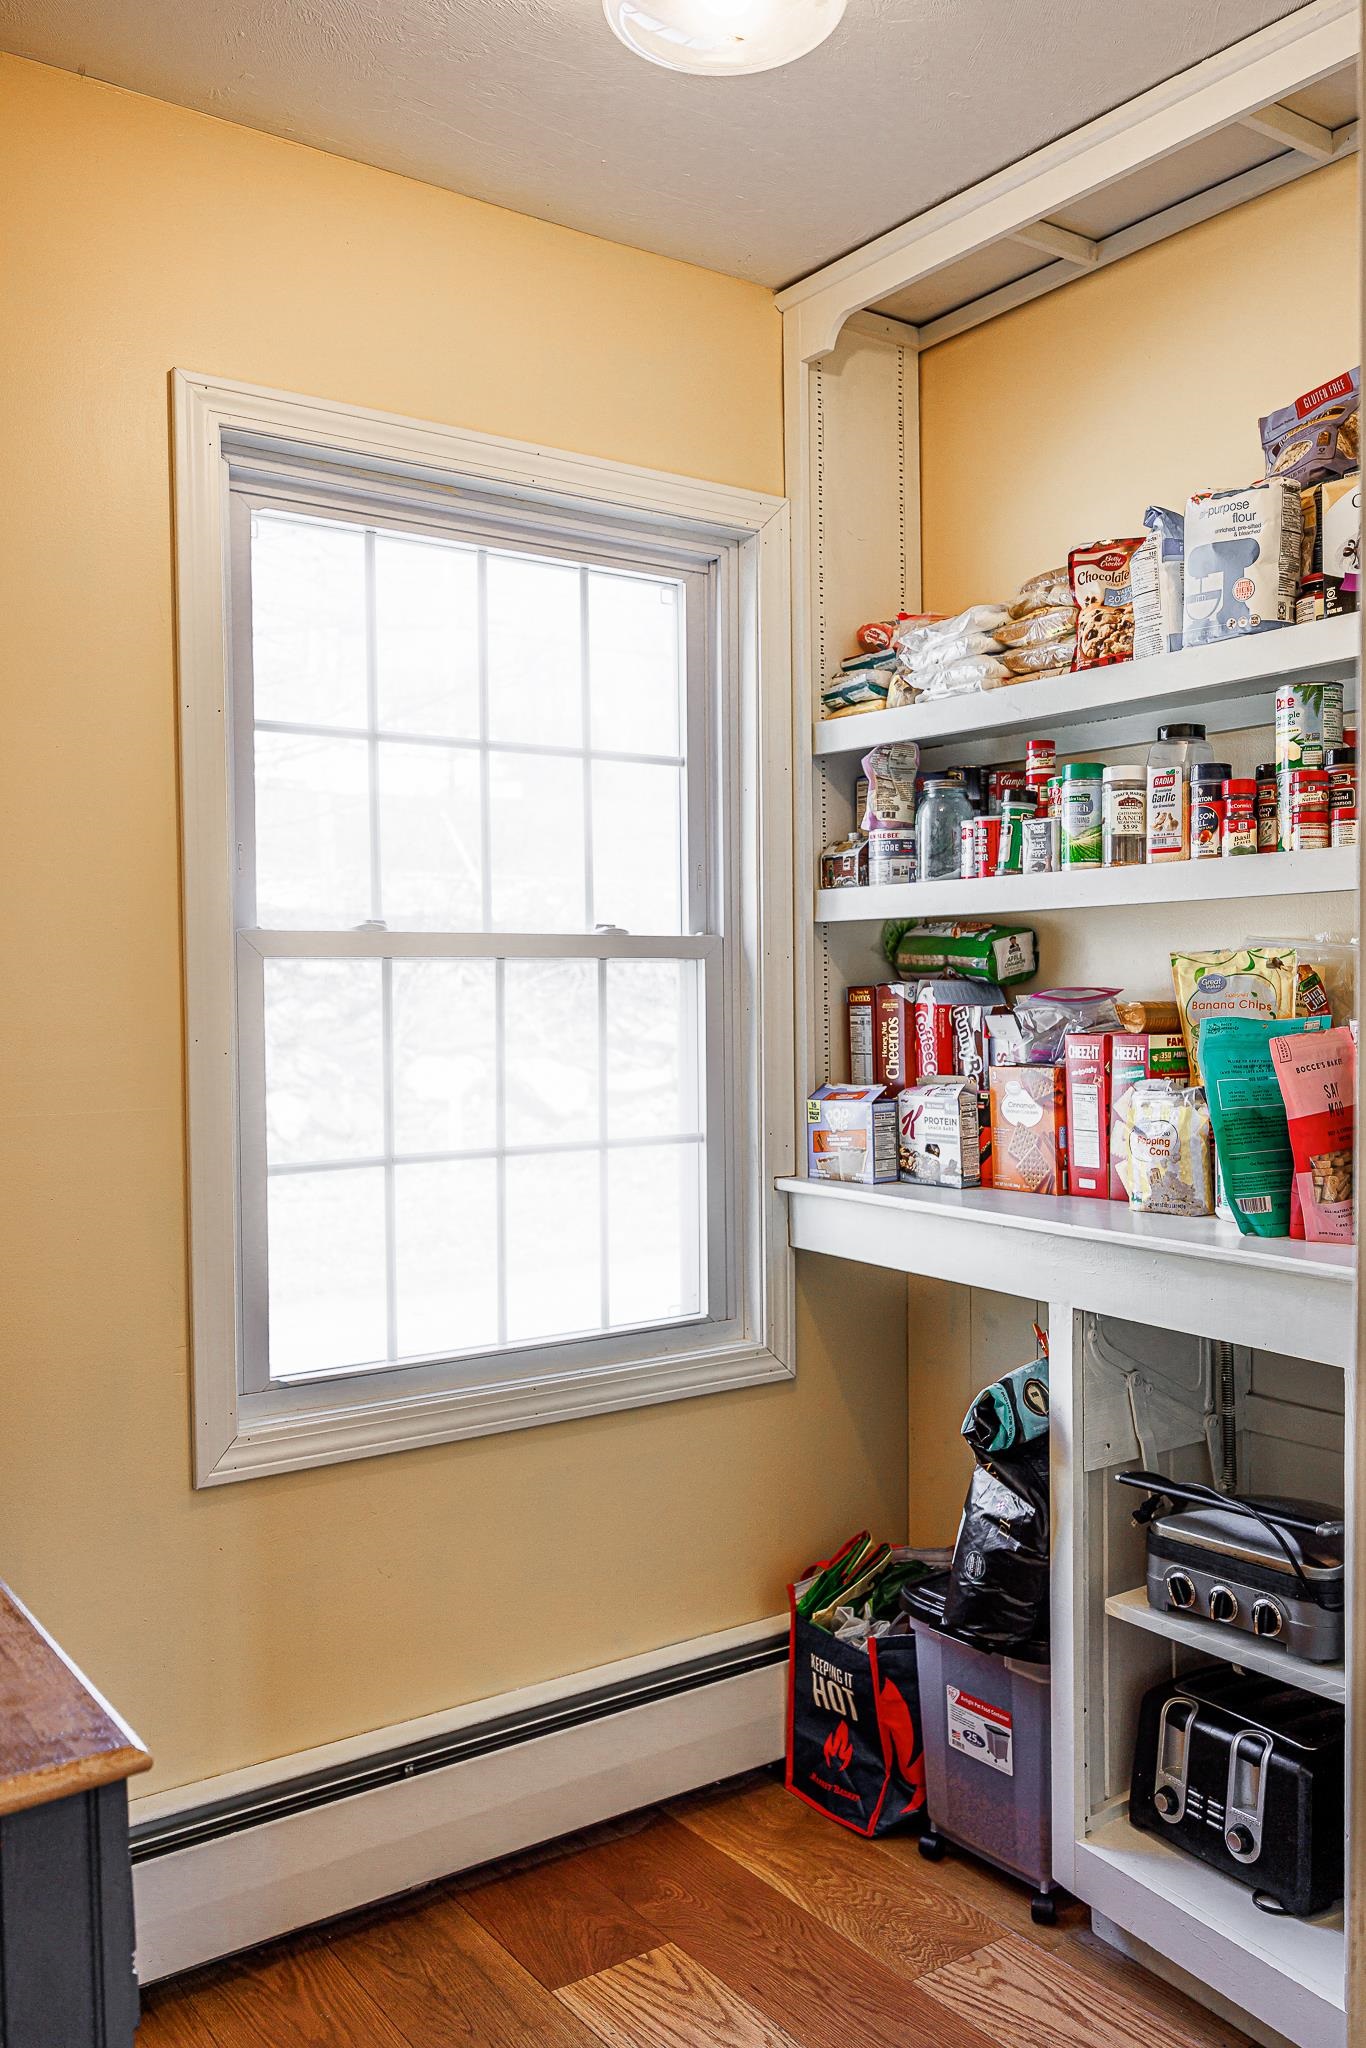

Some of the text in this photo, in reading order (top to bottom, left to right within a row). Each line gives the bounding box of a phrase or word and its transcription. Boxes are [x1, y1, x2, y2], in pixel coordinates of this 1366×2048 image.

[1303, 378, 1346, 409] GLUTEN FREE
[1232, 511, 1257, 523] flour
[1100, 560, 1123, 568] Crocker
[1105, 554, 1122, 562] Betty
[1077, 570, 1130, 586] Chocolate
[1154, 776, 1174, 786] BADIA
[1151, 793, 1176, 804] Garlic
[1234, 834, 1251, 842] Basil
[1008, 953, 1023, 961] APPLE
[849, 993, 871, 1002] Cheerios
[1191, 999, 1272, 1011] Banana Chips
[885, 1016, 900, 1080] Cheerios
[1295, 1061, 1326, 1074] BOCCE'S
[1323, 1082, 1340, 1099] SAY
[1007, 1101, 1037, 1110] Cinnamon
[1327, 1100, 1345, 1117] MOO
[924, 1116, 957, 1126] PROTEIN
[1149, 1147, 1171, 1156] Corn
[810, 1652, 854, 1689] KEEPING IT
[811, 1671, 858, 1722] HOT
[980, 1705, 991, 1714] Food
[989, 1709, 1010, 1722] Container
[966, 1731, 978, 1743] 25
